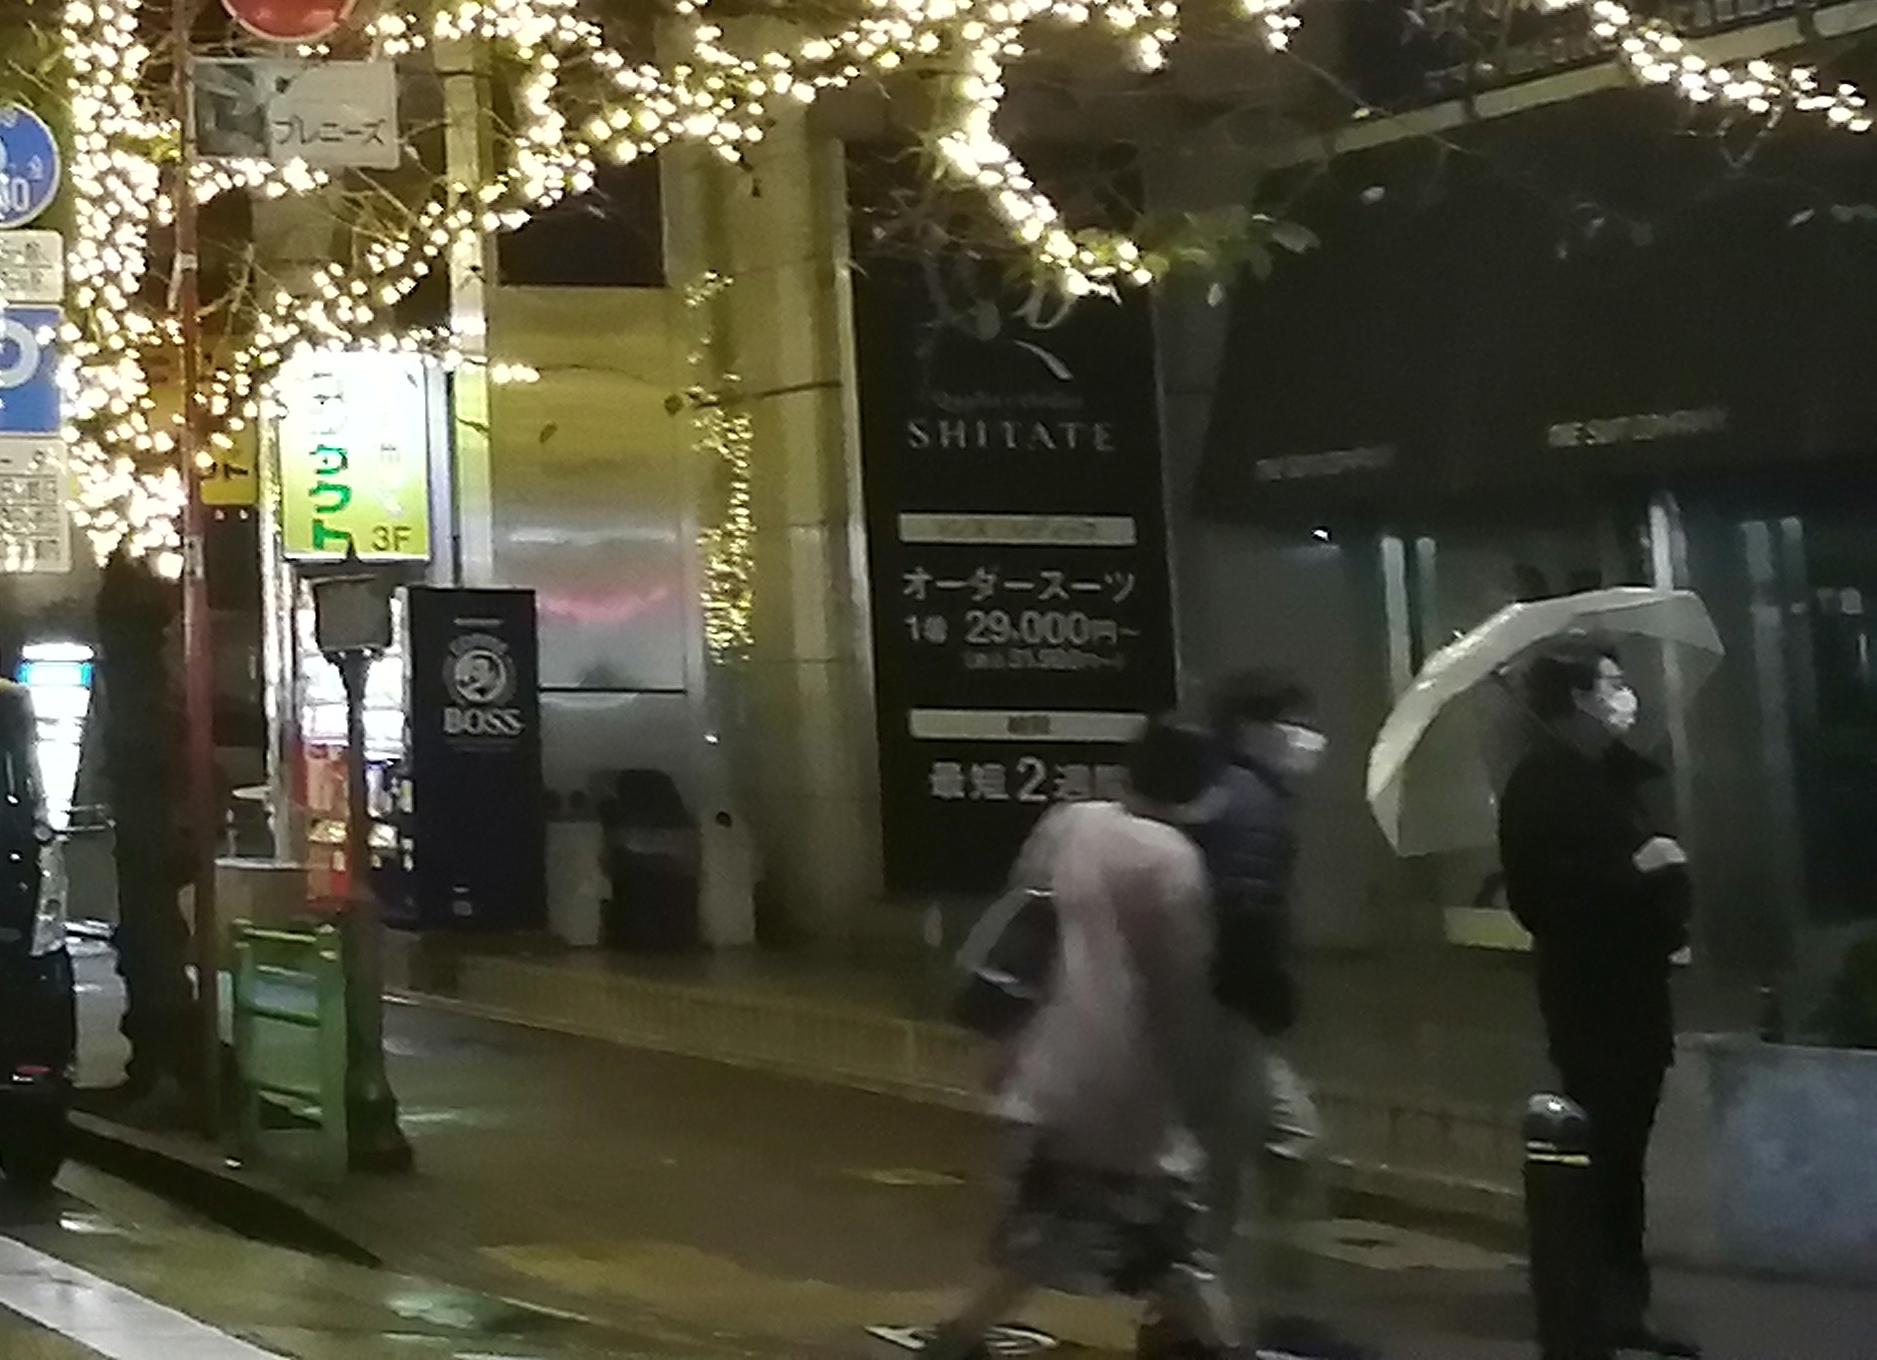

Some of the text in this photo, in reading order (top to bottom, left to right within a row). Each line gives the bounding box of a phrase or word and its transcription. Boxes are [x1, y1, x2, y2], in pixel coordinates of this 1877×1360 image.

[907, 419, 1115, 452] SHITATE
[371, 516, 412, 551] 3F
[901, 566, 1136, 604] オーダースーツ
[444, 706, 526, 736] BOSS
